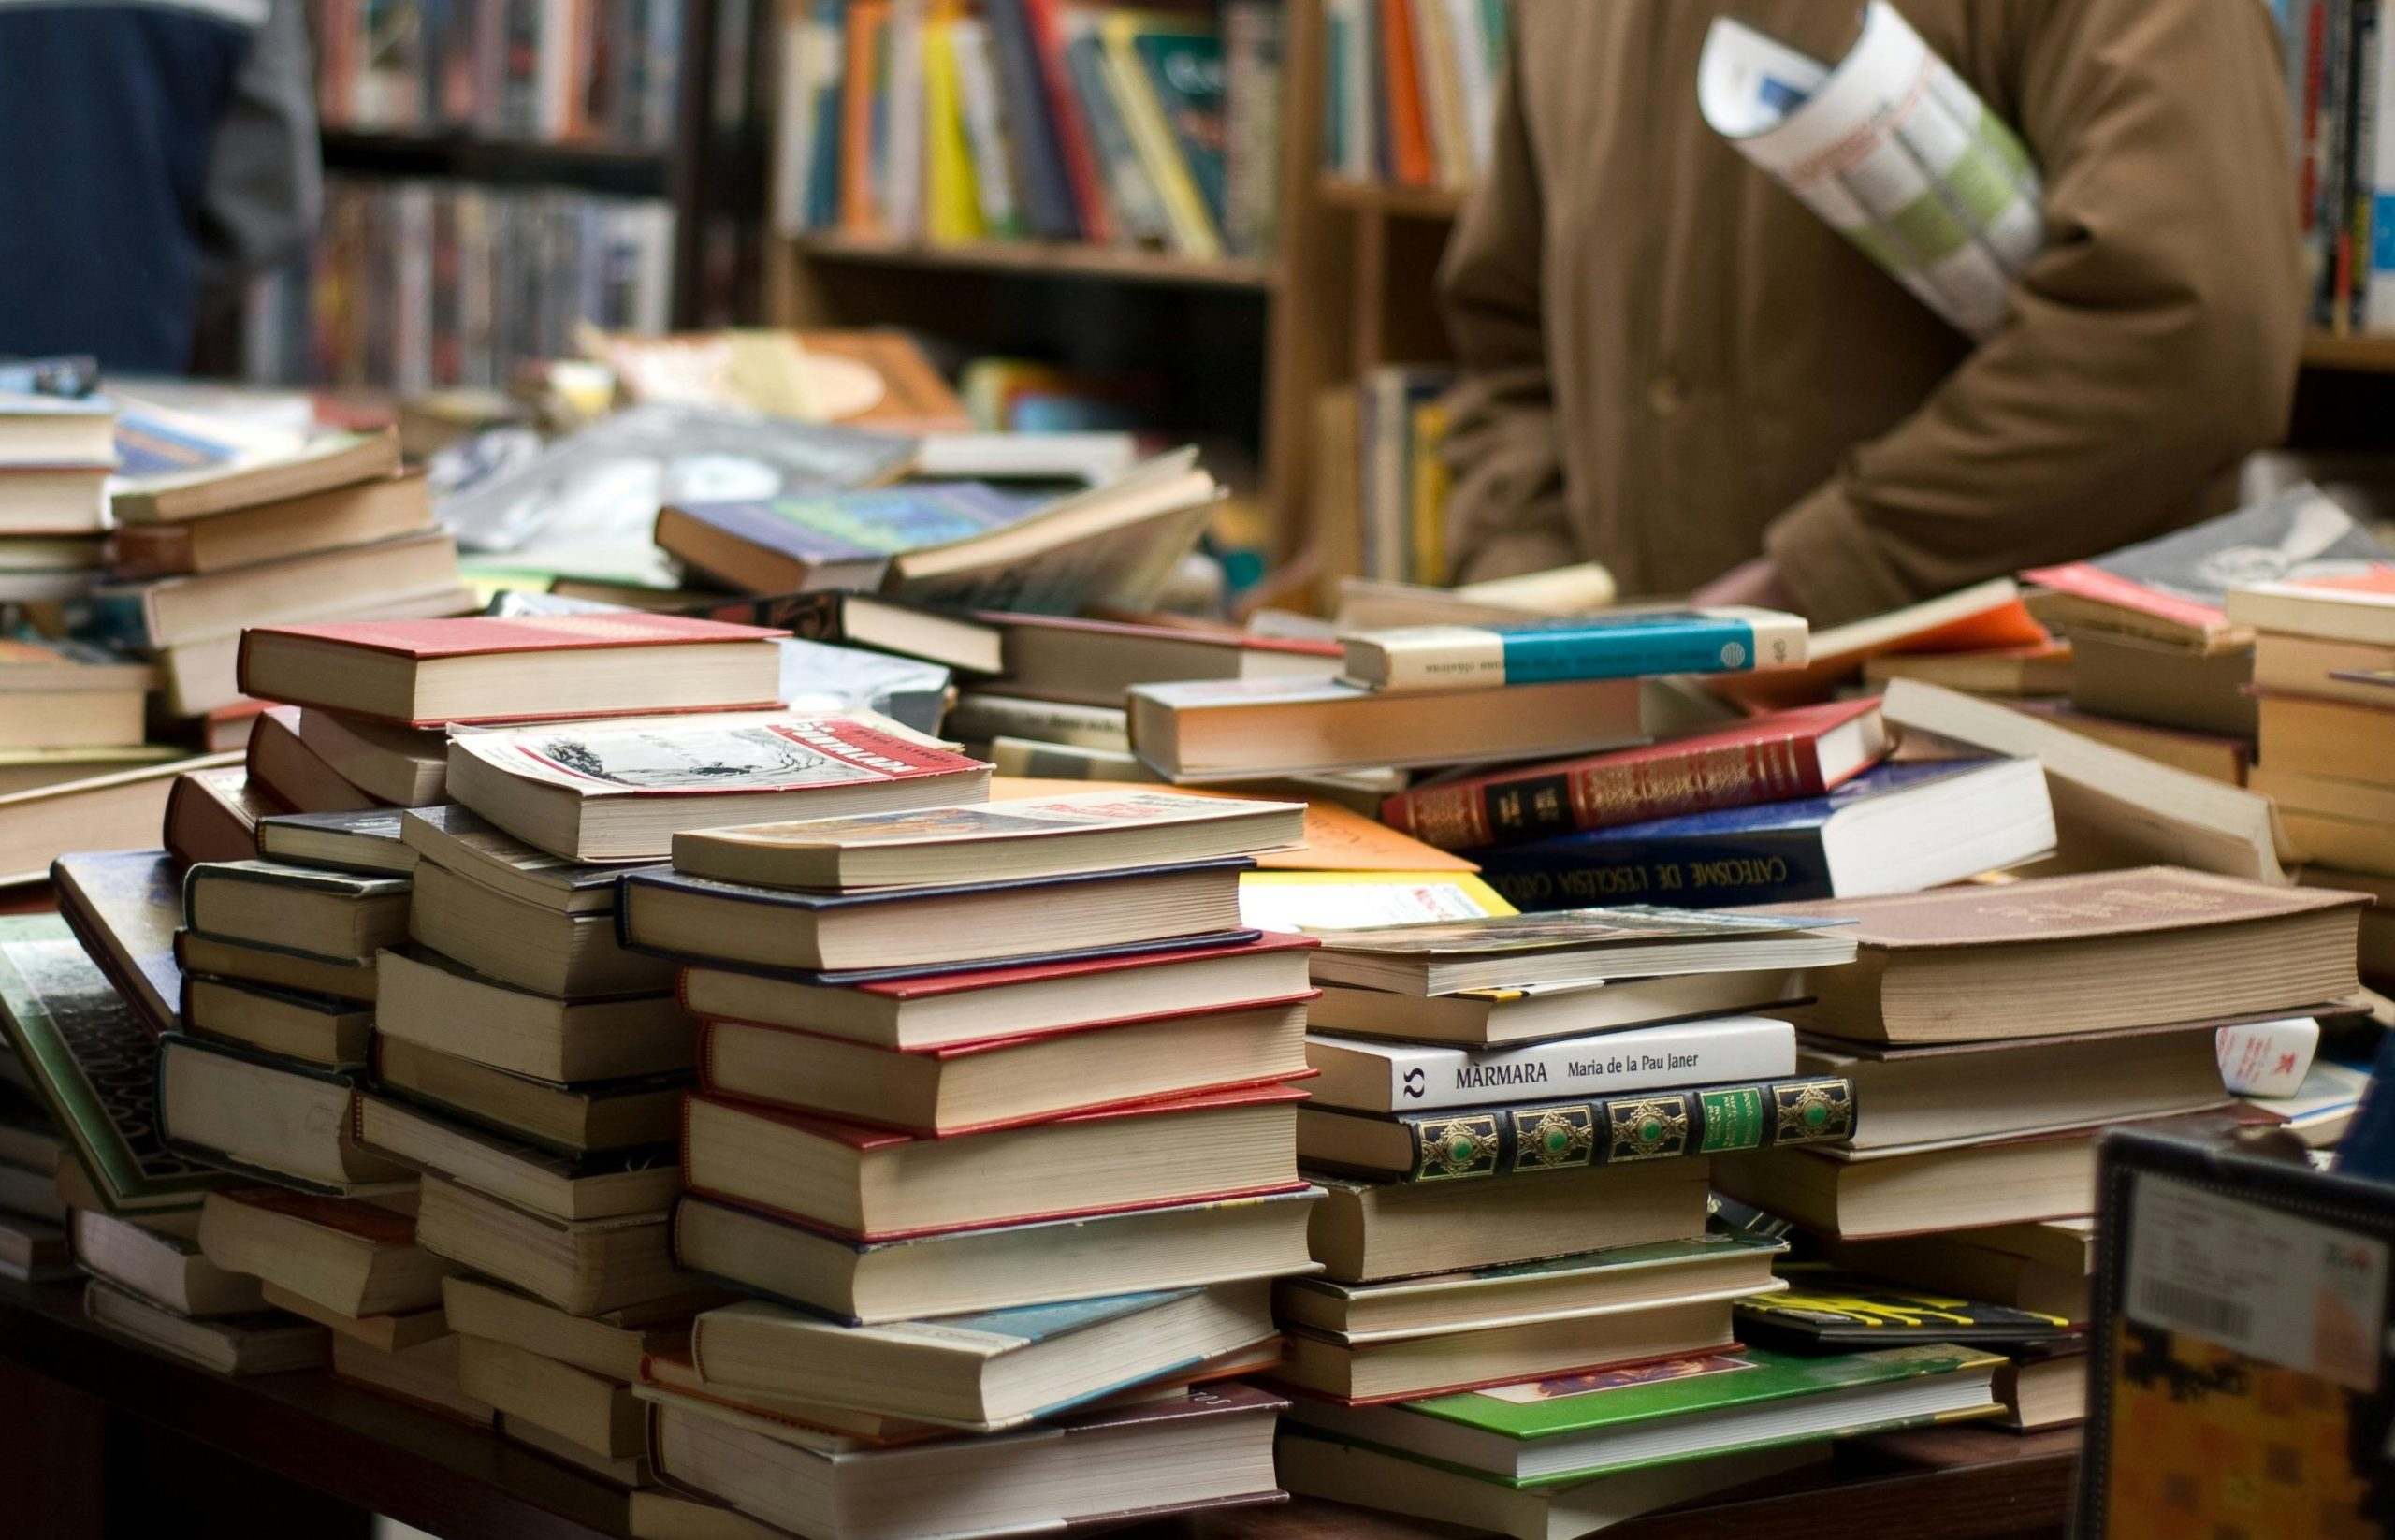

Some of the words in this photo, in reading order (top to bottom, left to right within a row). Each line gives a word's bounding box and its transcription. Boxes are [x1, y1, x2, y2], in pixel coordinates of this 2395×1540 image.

[1654, 862, 1682, 890] DE
[1455, 1062, 1548, 1089] MÀRMARA
[1567, 1059, 1604, 1077] Maria
[1607, 1056, 1623, 1074] de
[1626, 1054, 1637, 1072] la
[1642, 1054, 1663, 1071] Pau
[1667, 1053, 1699, 1071] Janer
